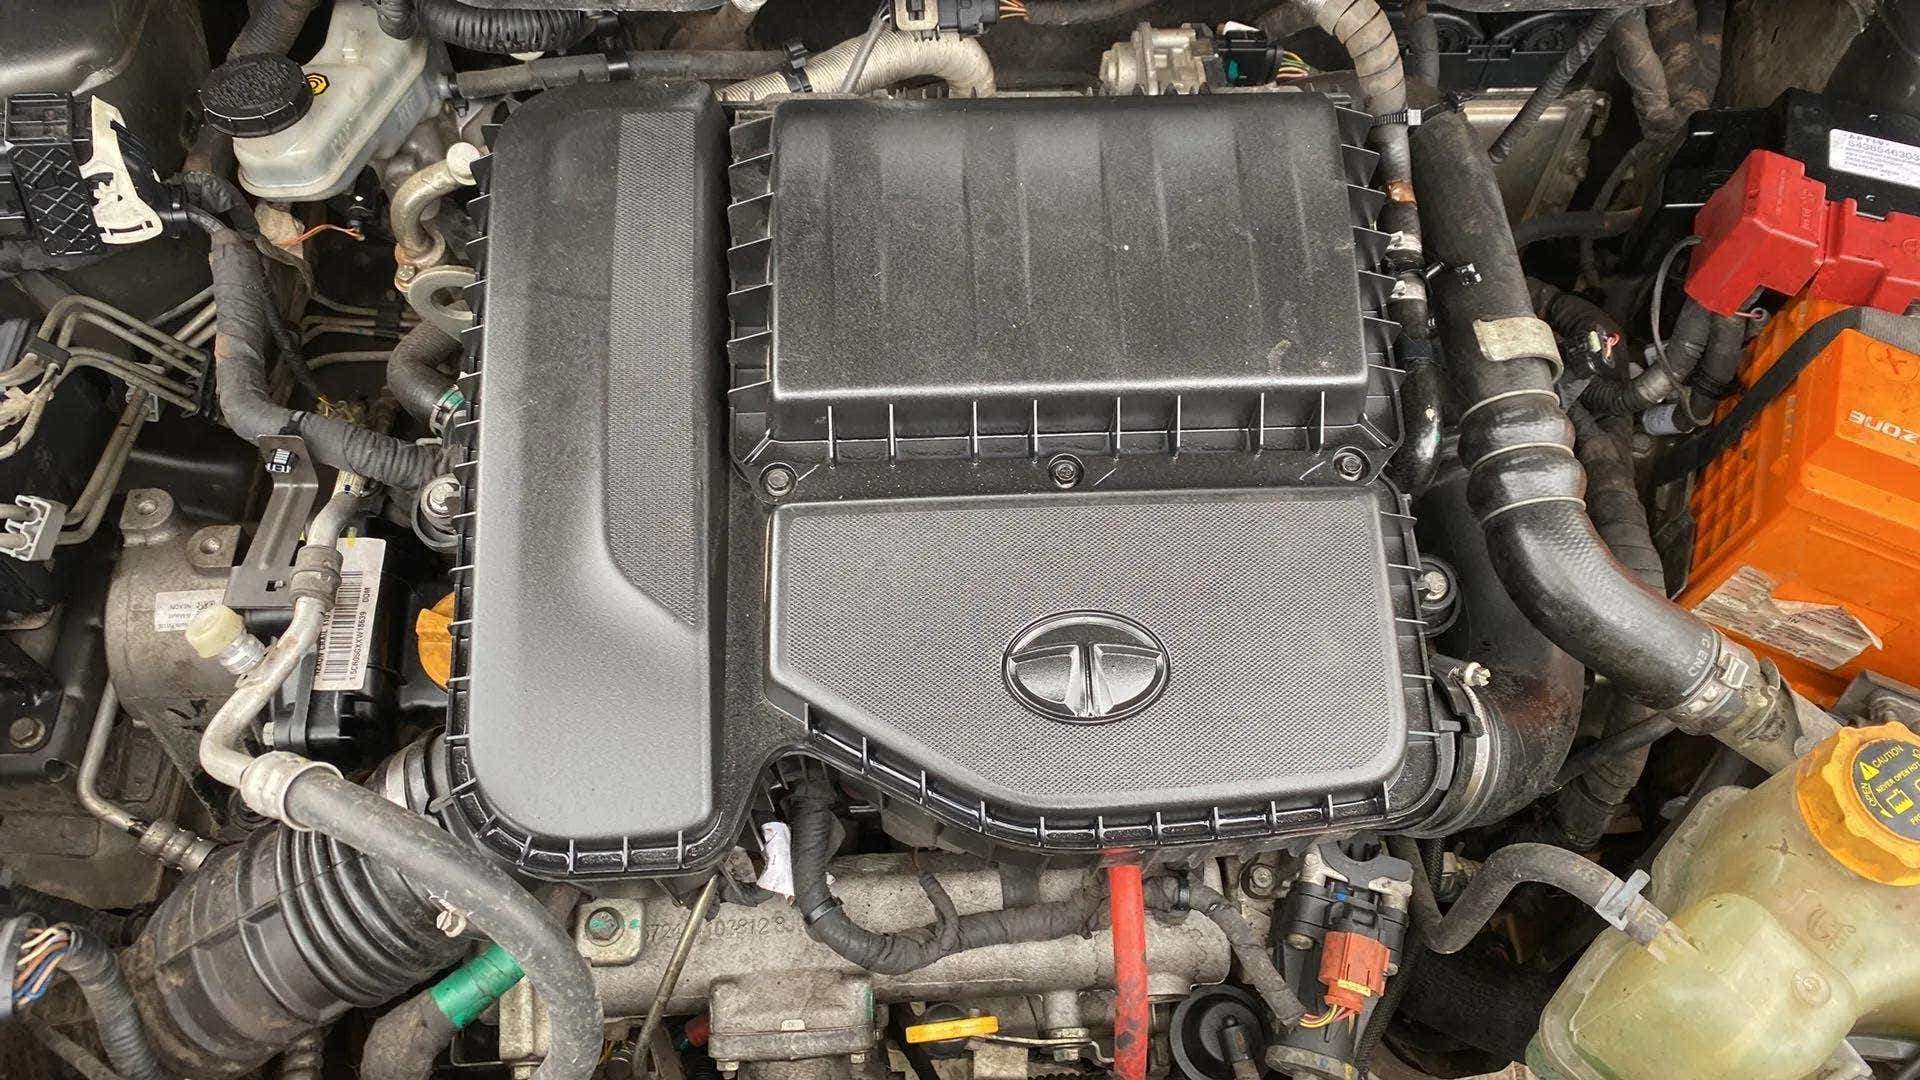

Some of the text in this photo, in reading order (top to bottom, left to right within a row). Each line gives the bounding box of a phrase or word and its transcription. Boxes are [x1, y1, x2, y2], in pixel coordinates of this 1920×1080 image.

[1872, 744, 1904, 768] CAUTION
[1860, 782, 1878, 806] OPEN
[1875, 777, 1896, 793] NEVER
